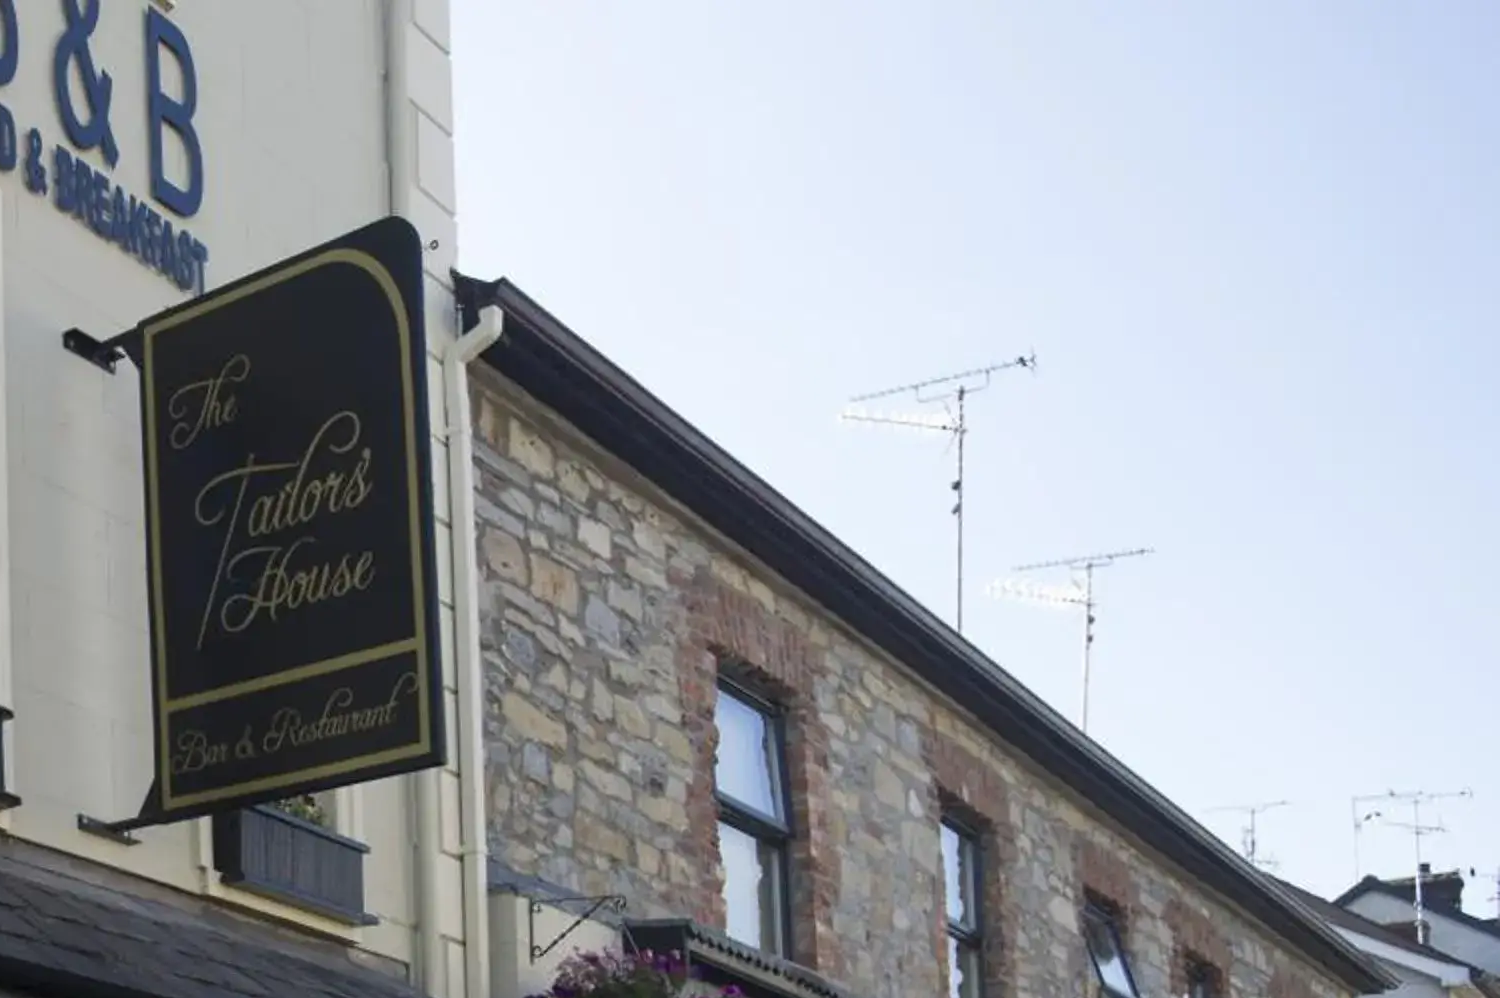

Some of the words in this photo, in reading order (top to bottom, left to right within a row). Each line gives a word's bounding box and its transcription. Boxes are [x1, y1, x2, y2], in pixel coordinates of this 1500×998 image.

[25, 127, 47, 195] &
[54, 144, 207, 298] BREAKFAST
[169, 354, 250, 449] The
[221, 537, 376, 632] House
[173, 730, 227, 774] Bar
[263, 672, 419, 752] Restaurant
